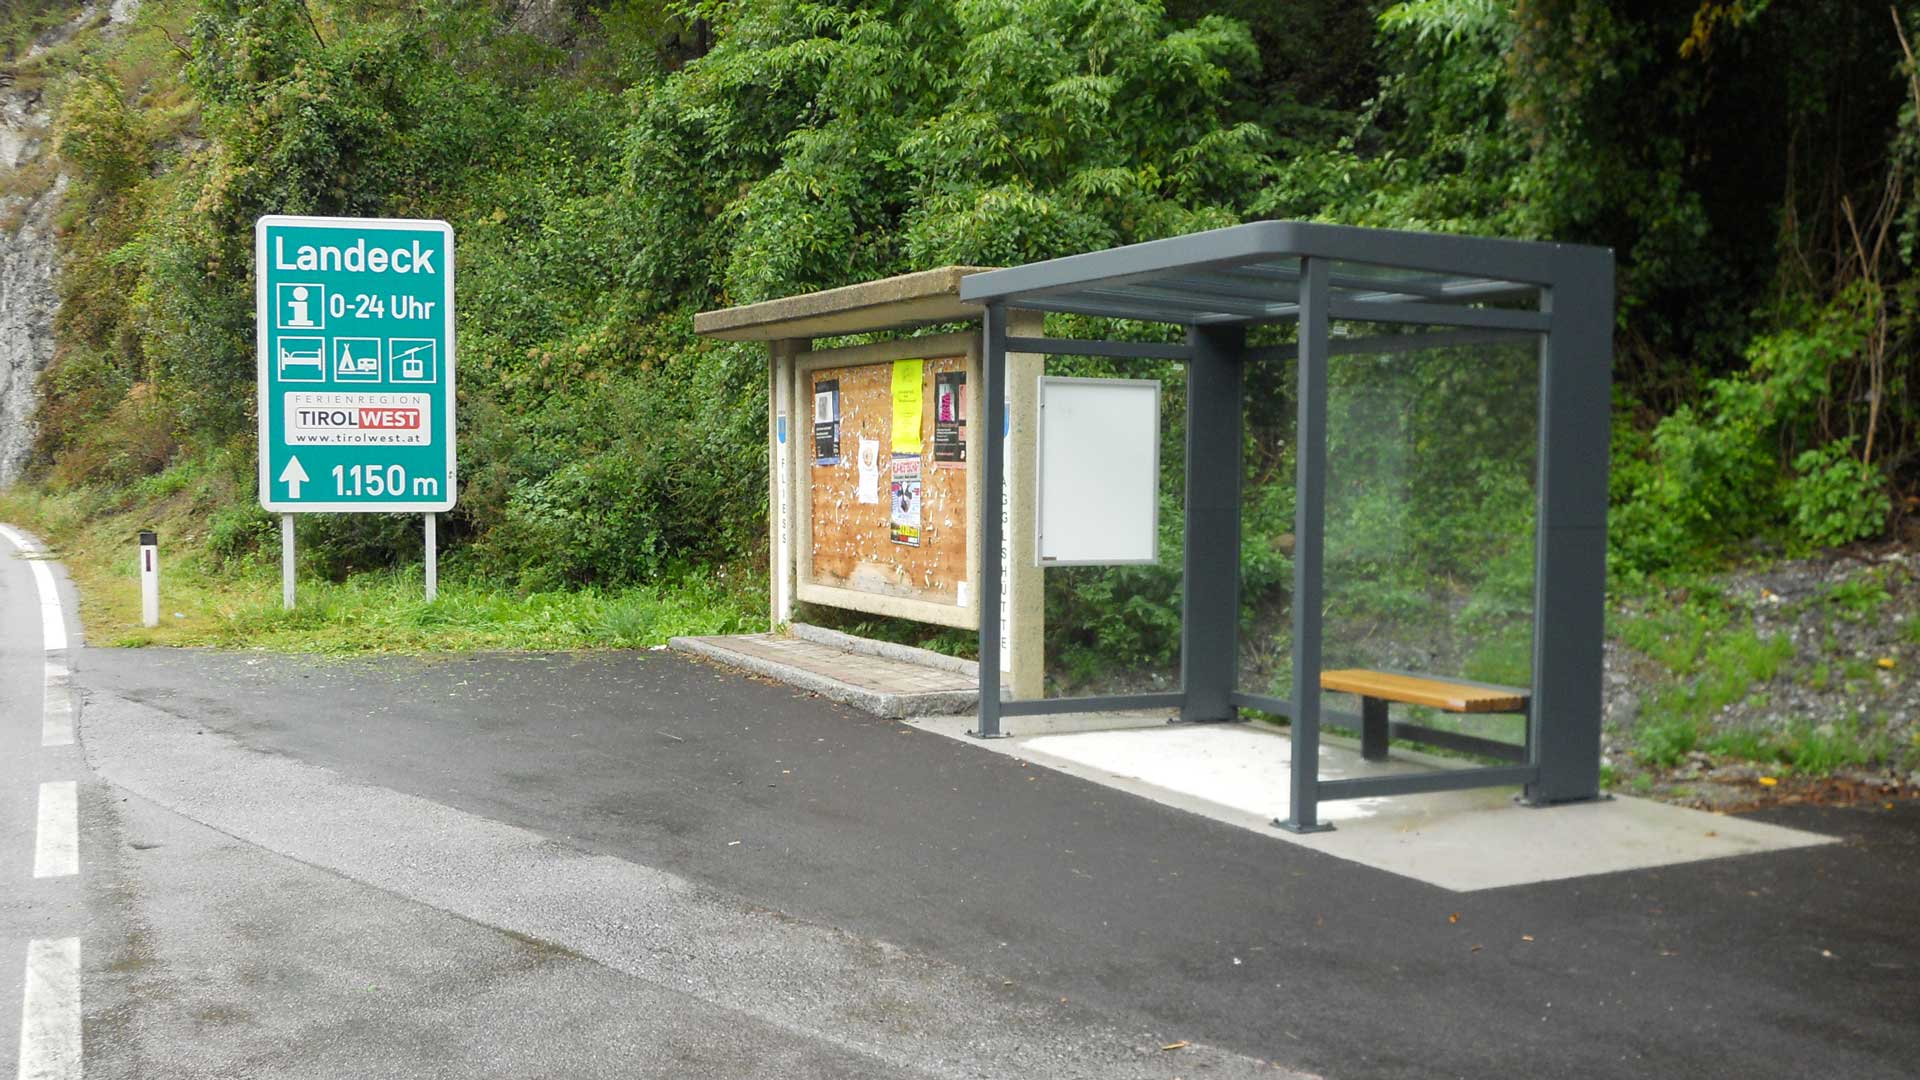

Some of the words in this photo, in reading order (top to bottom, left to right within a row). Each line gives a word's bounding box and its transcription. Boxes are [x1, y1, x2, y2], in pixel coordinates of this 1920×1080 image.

[275, 236, 435, 274] Landeck
[329, 293, 385, 319] 0-24
[391, 295, 436, 320] Uhr
[295, 394, 421, 405] FERIENREGION
[296, 432, 420, 443] www.tirolwest.at
[331, 464, 406, 496] 1.150
[412, 476, 438, 496] m
